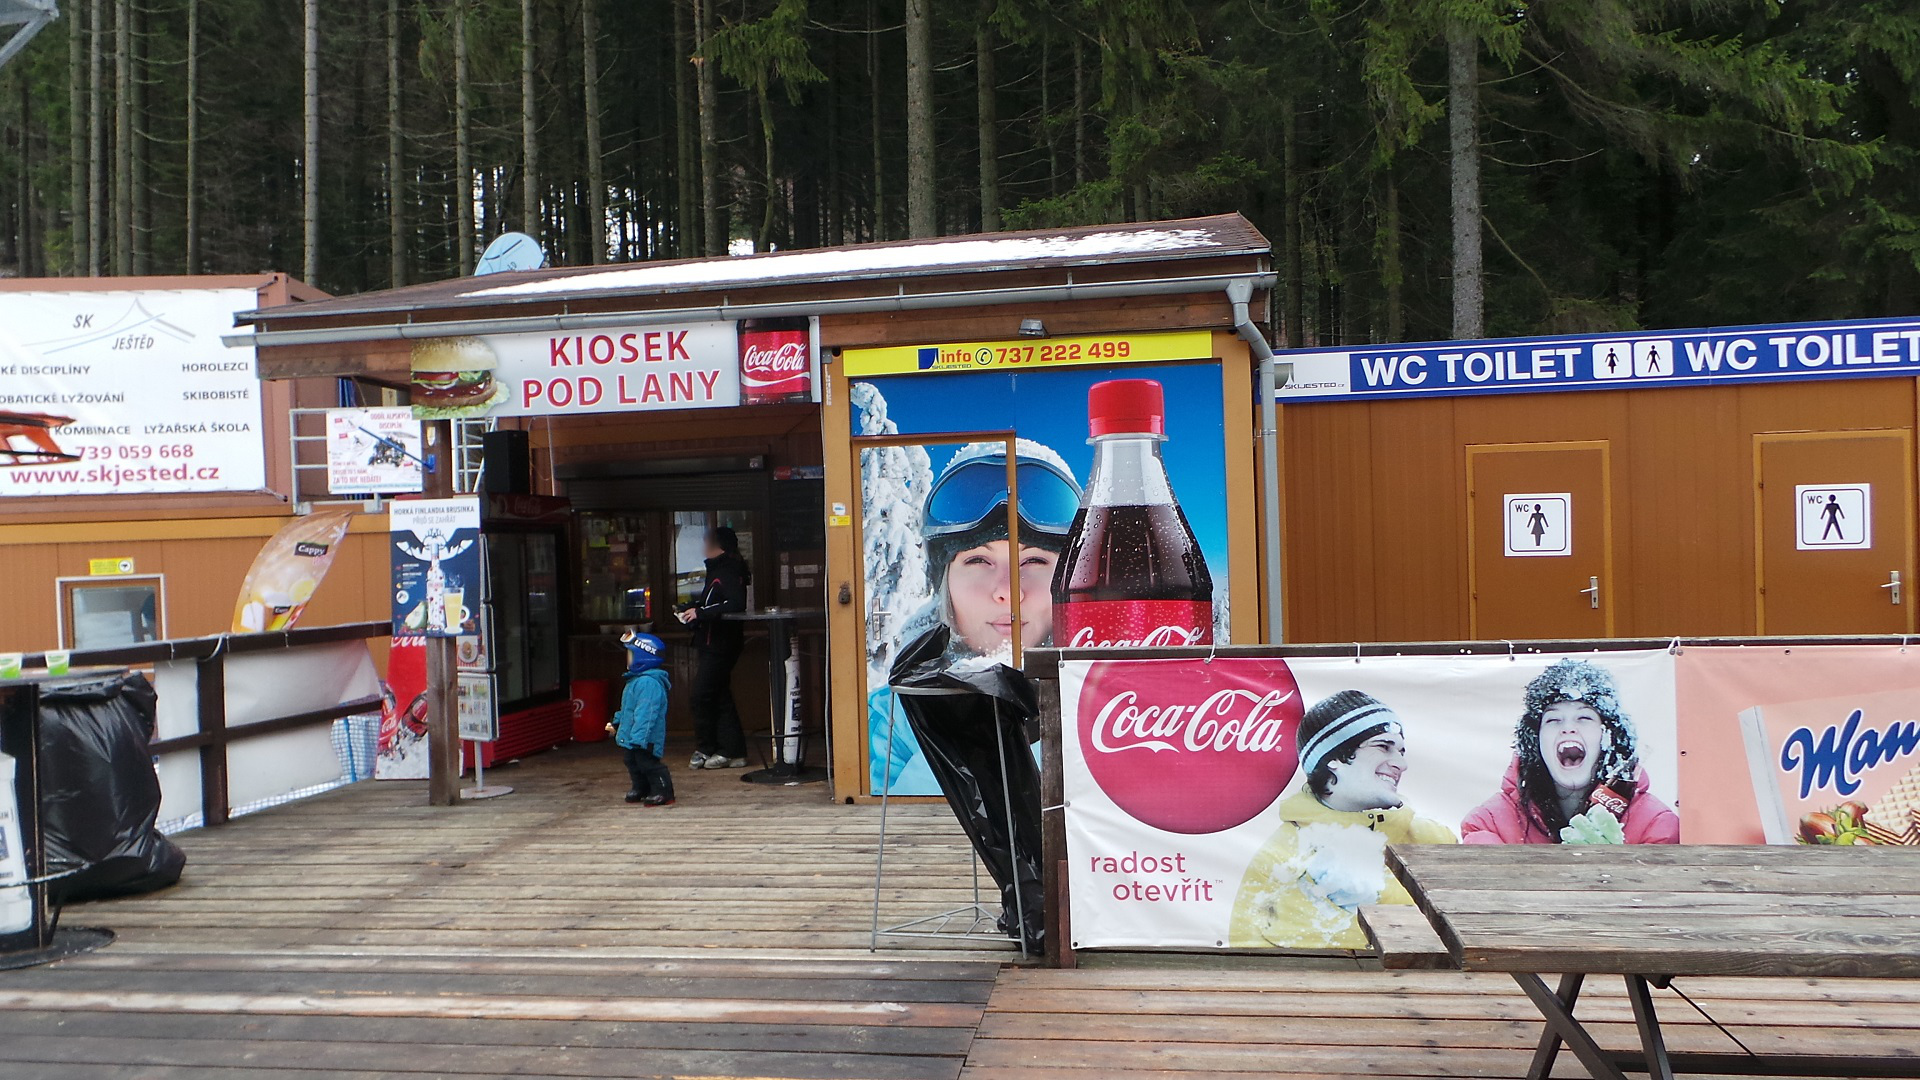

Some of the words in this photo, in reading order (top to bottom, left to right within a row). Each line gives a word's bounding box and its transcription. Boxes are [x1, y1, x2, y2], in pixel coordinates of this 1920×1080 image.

[73, 314, 94, 329] SK
[112, 334, 154, 350] JEŠTĚD
[550, 330, 691, 367] KIOSEK
[743, 343, 806, 373] Coca-Cola
[941, 349, 972, 364] info
[995, 346, 1035, 364] 737
[1040, 344, 1081, 362] 222
[1087, 341, 1130, 359] 499
[1684, 338, 1757, 371] WC
[1768, 330, 1920, 368] TOILET
[21, 363, 91, 376] DISCIPLÍNY
[182, 362, 249, 372] HOROLEZCI
[1361, 355, 1427, 387] WC
[1438, 347, 1582, 383] TOILET
[183, 388, 249, 400] SKIBOBISTÉ
[522, 376, 603, 408] POD
[617, 370, 721, 405] LANY
[61, 391, 125, 404] LYŽOVÁNÍ
[55, 425, 131, 436] KOMBINACE
[144, 422, 207, 435] LYŽAŘSKÁ
[211, 421, 250, 433] ŠKOLA
[75, 445, 112, 461] 739
[119, 445, 152, 460] 059
[159, 444, 194, 458] 668
[10, 463, 220, 486] www.skjested.cz
[1806, 495, 1823, 504] WC
[1514, 504, 1530, 513] WC
[298, 545, 325, 555] Cappy
[634, 639, 657, 655] uvex
[1091, 689, 1295, 754] Coca-Cola
[1780, 709, 1920, 799] Man
[1090, 851, 1186, 874] radost
[1112, 878, 1213, 901] otevřít
